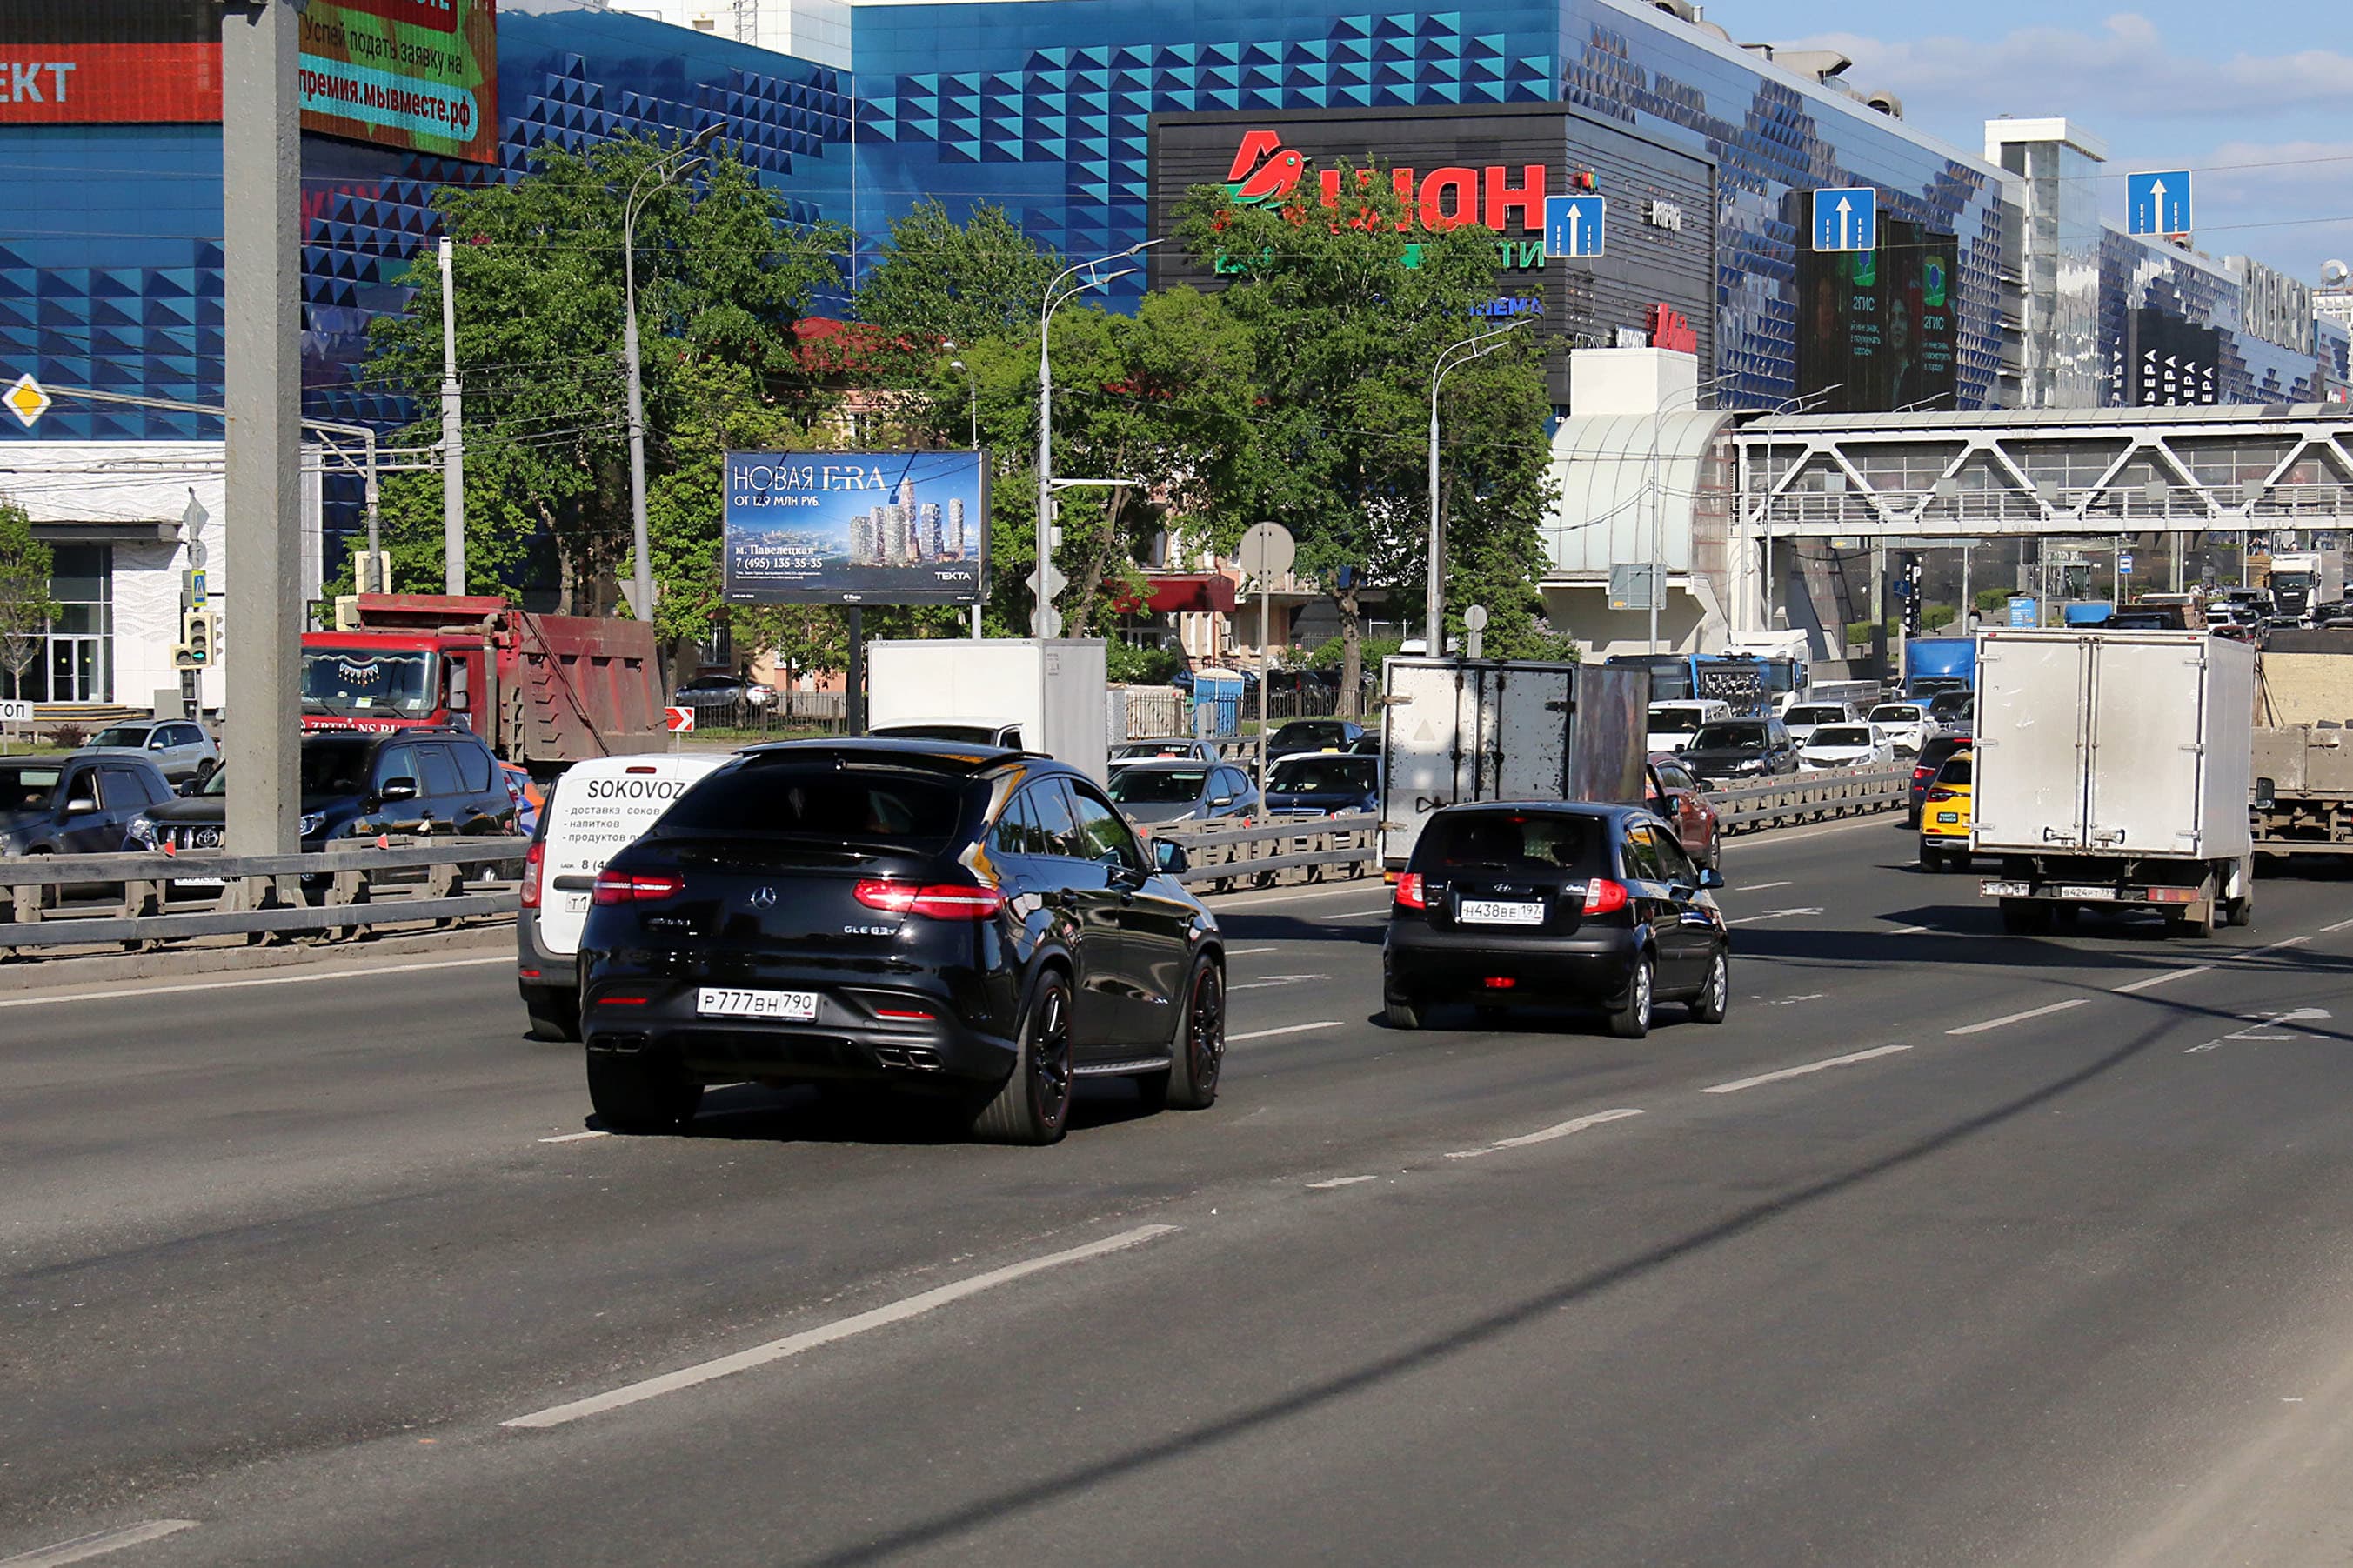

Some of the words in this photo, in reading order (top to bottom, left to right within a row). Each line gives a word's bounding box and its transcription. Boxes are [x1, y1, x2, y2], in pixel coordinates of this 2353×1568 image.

[305, 15, 345, 44] Успей
[351, 30, 397, 60] подать
[400, 43, 445, 77] заявку
[448, 54, 463, 75] на
[299, 69, 471, 132] премия.мывместе.рф
[1853, 295, 1876, 312] 2ГИС
[1923, 315, 1945, 330] 2ГИС
[734, 465, 813, 490] НОВАЯ
[822, 465, 887, 491] ERA
[734, 496, 749, 506] ОТ
[752, 496, 771, 508] 12,9
[773, 496, 798, 506] МЛН
[801, 496, 820, 507] РУБ.
[751, 544, 814, 556] Павелецкая
[736, 558, 742, 568] 7
[745, 557, 770, 570] (495)
[773, 557, 823, 568] 135-35-35
[935, 571, 971, 580] ТЕКТА
[587, 780, 685, 799] SOKOVOZ
[571, 806, 620, 816] доставка
[568, 833, 626, 844] продуктов
[581, 860, 589, 869] 8
[783, 994, 812, 1010] 790
